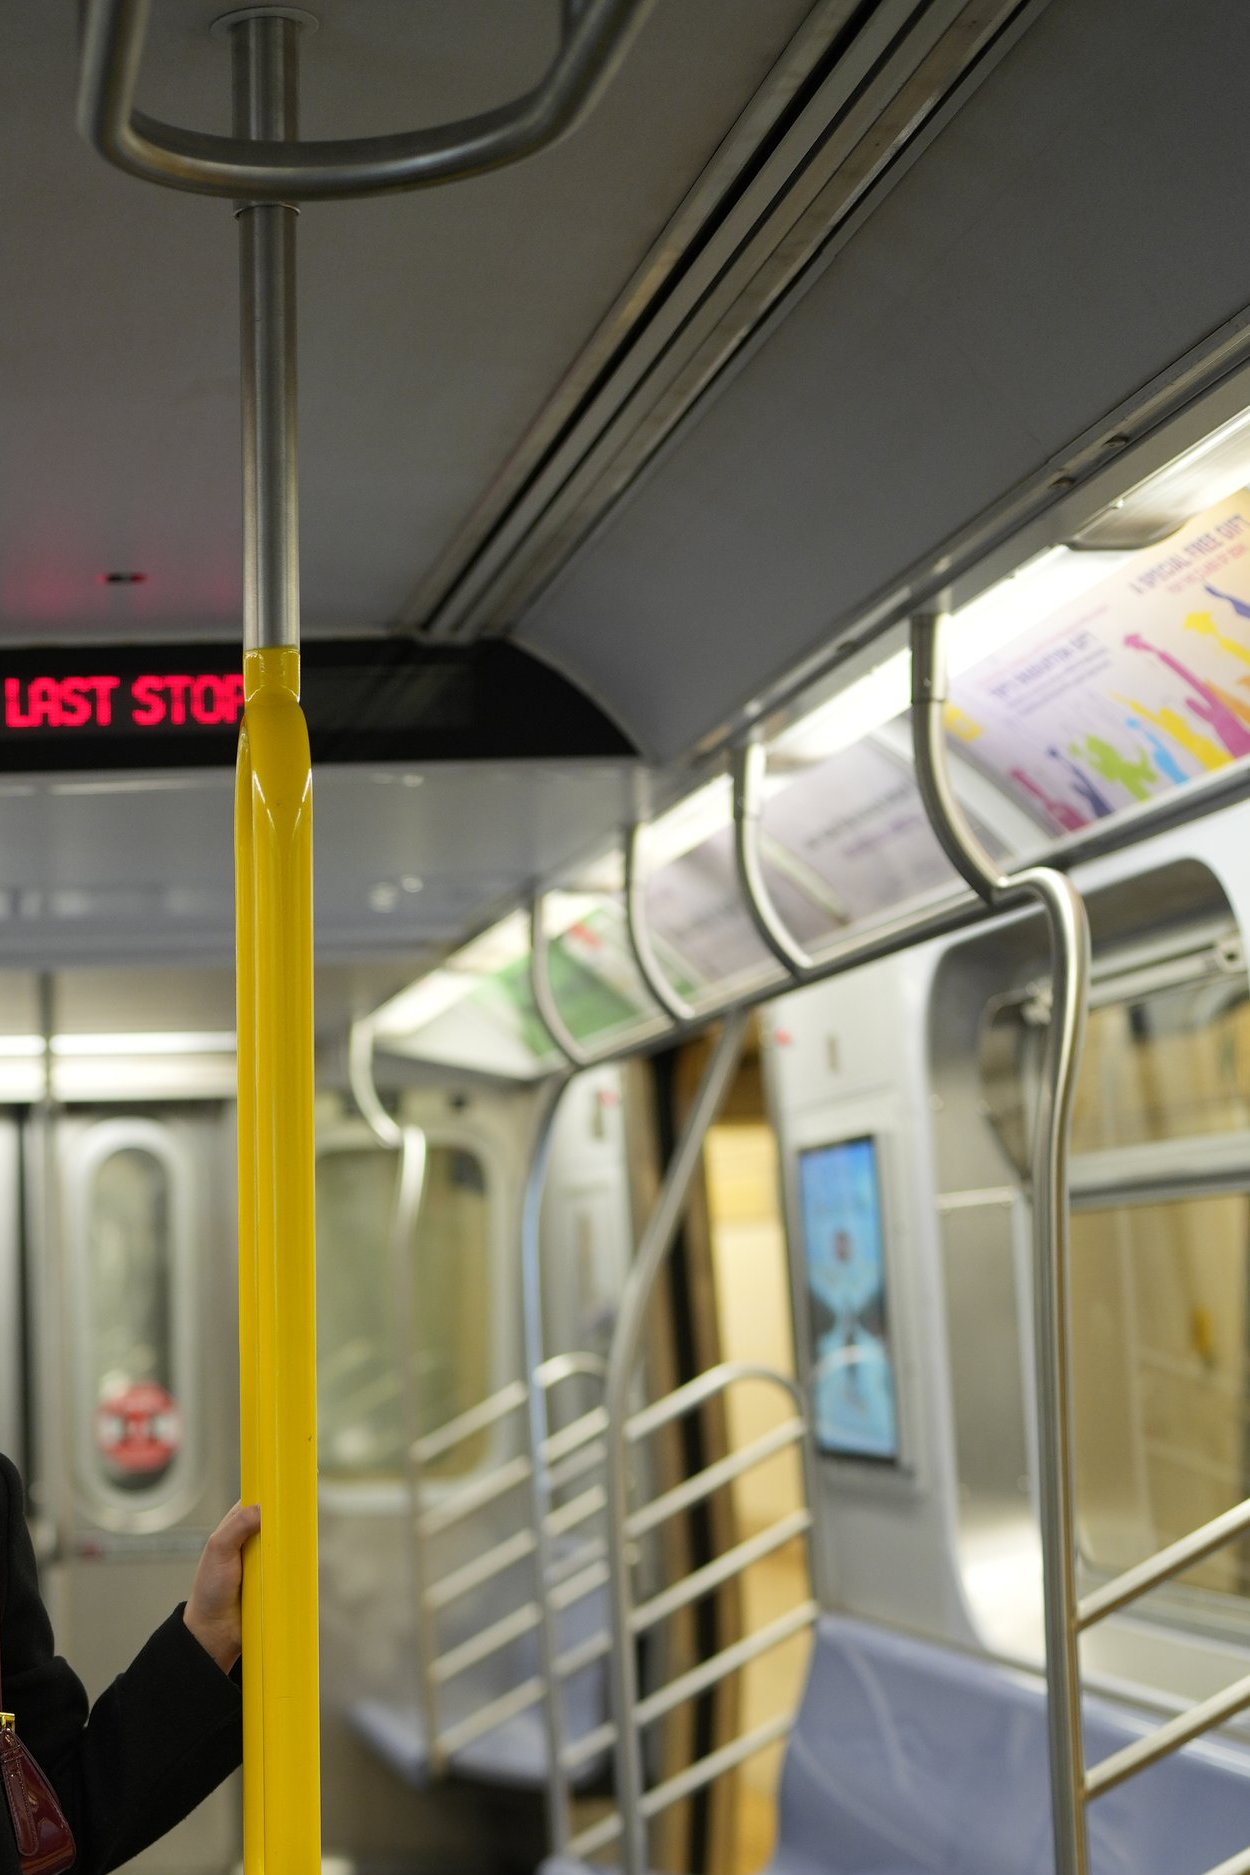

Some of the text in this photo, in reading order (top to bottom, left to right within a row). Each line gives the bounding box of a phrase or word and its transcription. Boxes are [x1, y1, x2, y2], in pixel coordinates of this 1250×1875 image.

[1183, 533, 1223, 558] FREE
[4, 675, 121, 728] LAST
[130, 673, 244, 726] STOP
